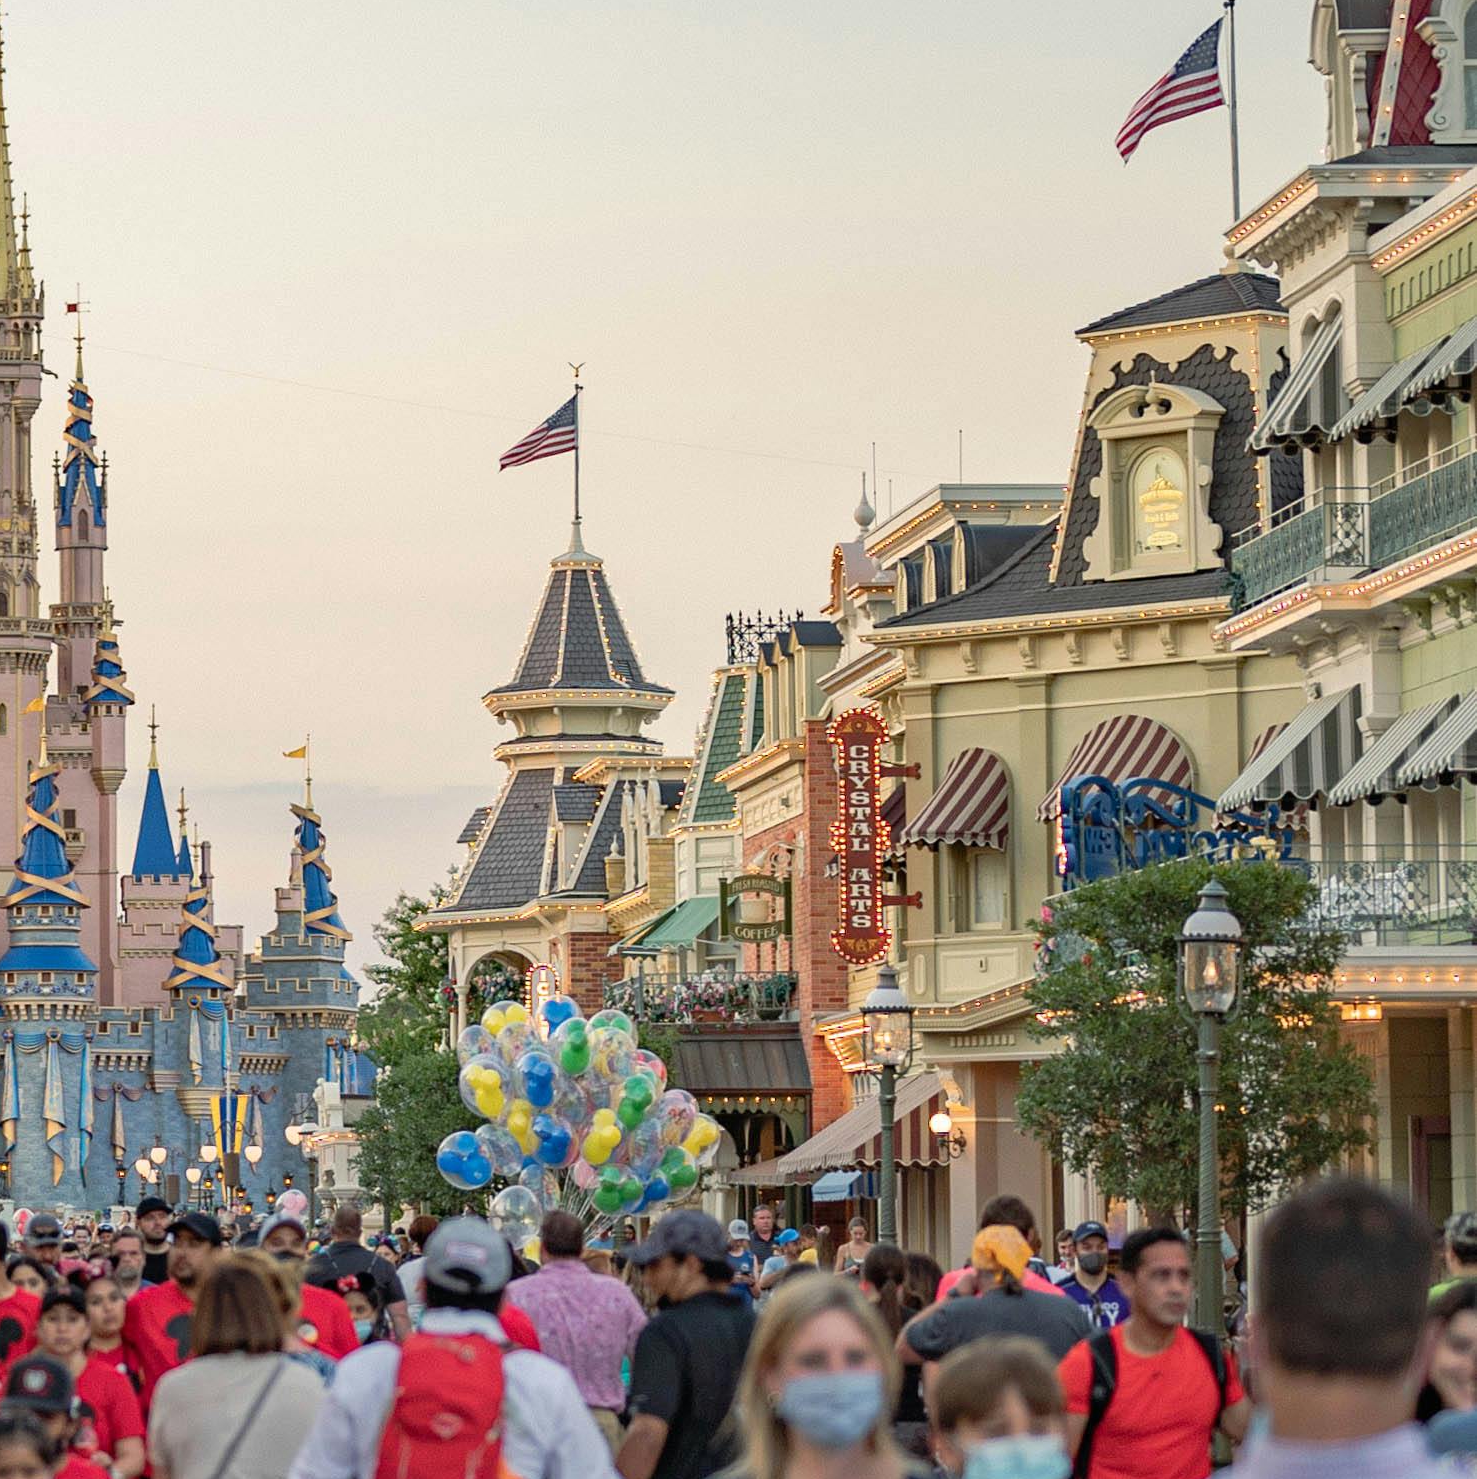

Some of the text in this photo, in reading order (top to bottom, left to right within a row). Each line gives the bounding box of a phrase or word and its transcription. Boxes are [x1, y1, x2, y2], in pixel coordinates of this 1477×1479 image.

[848, 745, 873, 929] CRYSTAL ARTS
[734, 926, 779, 940] COFFEE
